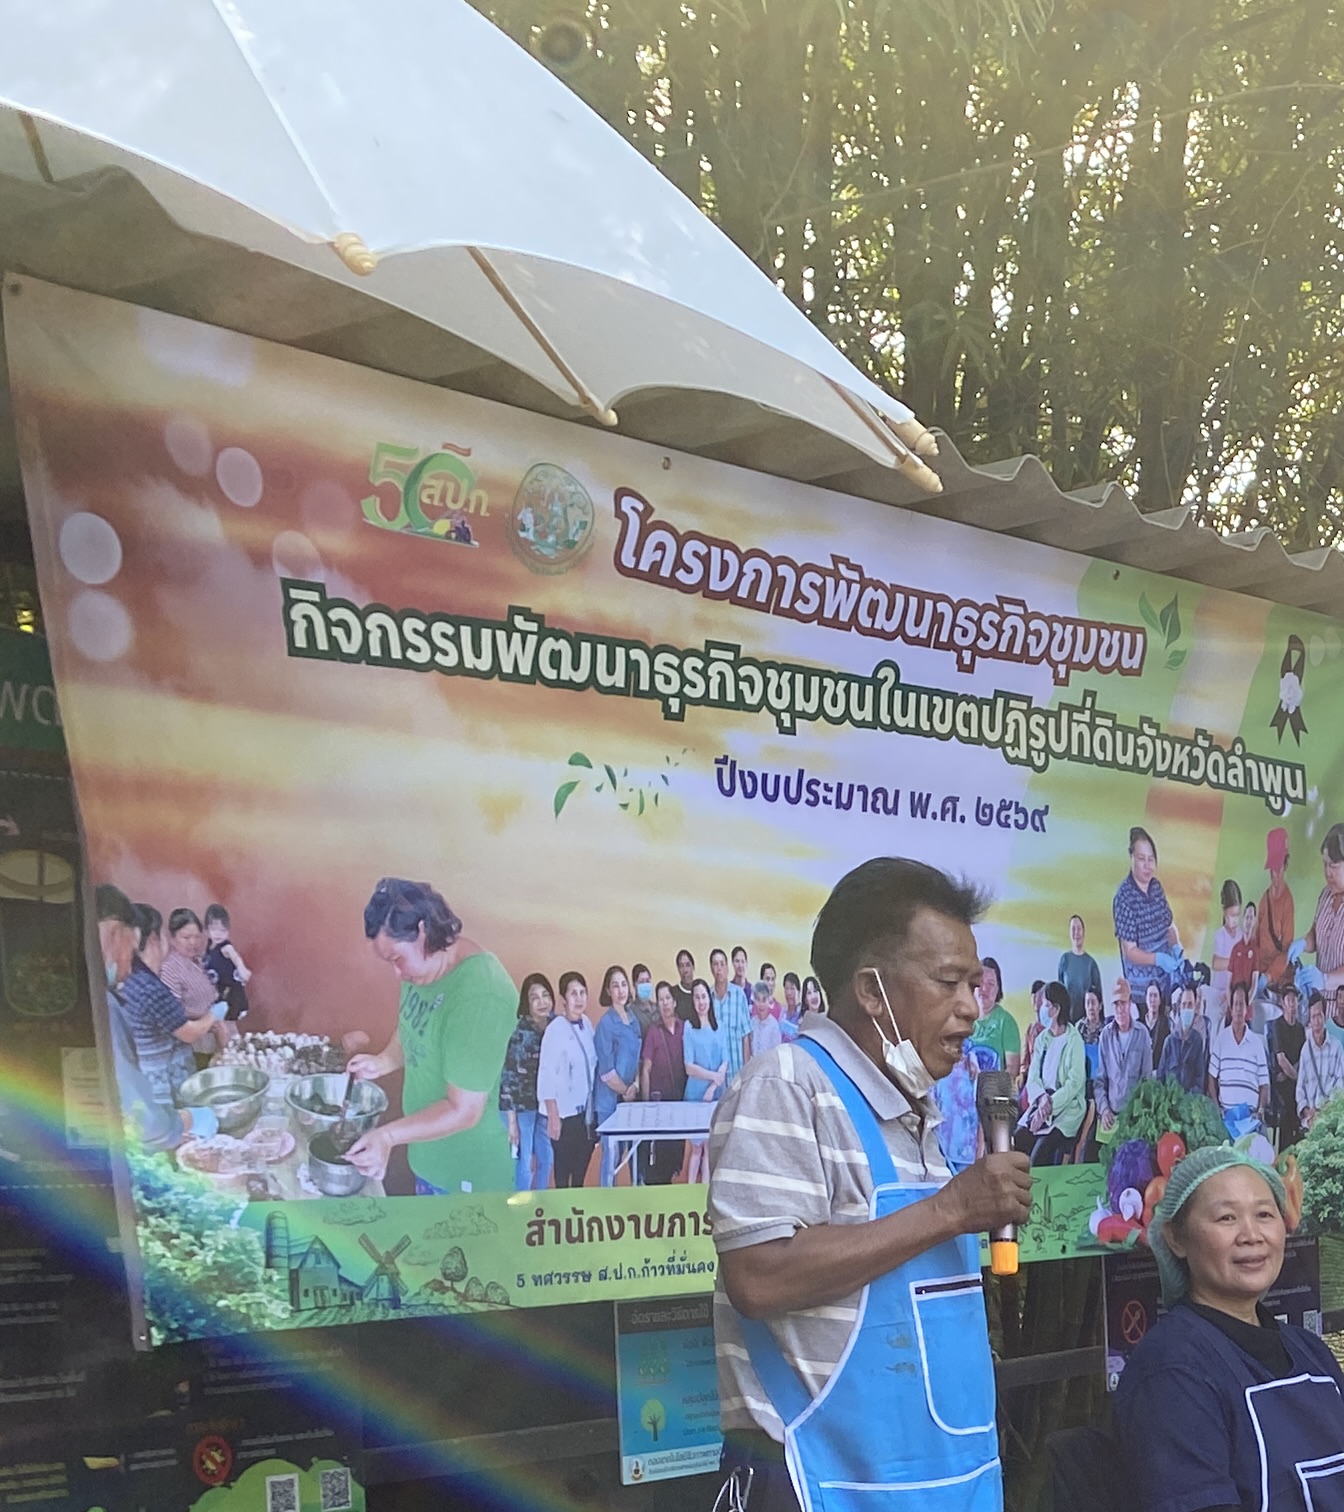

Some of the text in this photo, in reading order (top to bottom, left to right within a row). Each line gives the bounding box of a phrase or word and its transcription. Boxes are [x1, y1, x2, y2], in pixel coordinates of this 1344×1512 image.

[616, 490, 1145, 681] โครงการพัฒนาธุรกิจชุมชน
[288, 583, 1307, 814] กิจกรรมพัฒนาธุรกิจชุมชนในเขตปฏิรูปที่ดินจังหวัดลำพูน
[715, 756, 1049, 833] ปีงบประมาณ พ.ศ. ๒๕๖๙
[516, 1273, 525, 1288] 5
[531, 1270, 592, 1287] ทศวรรษ
